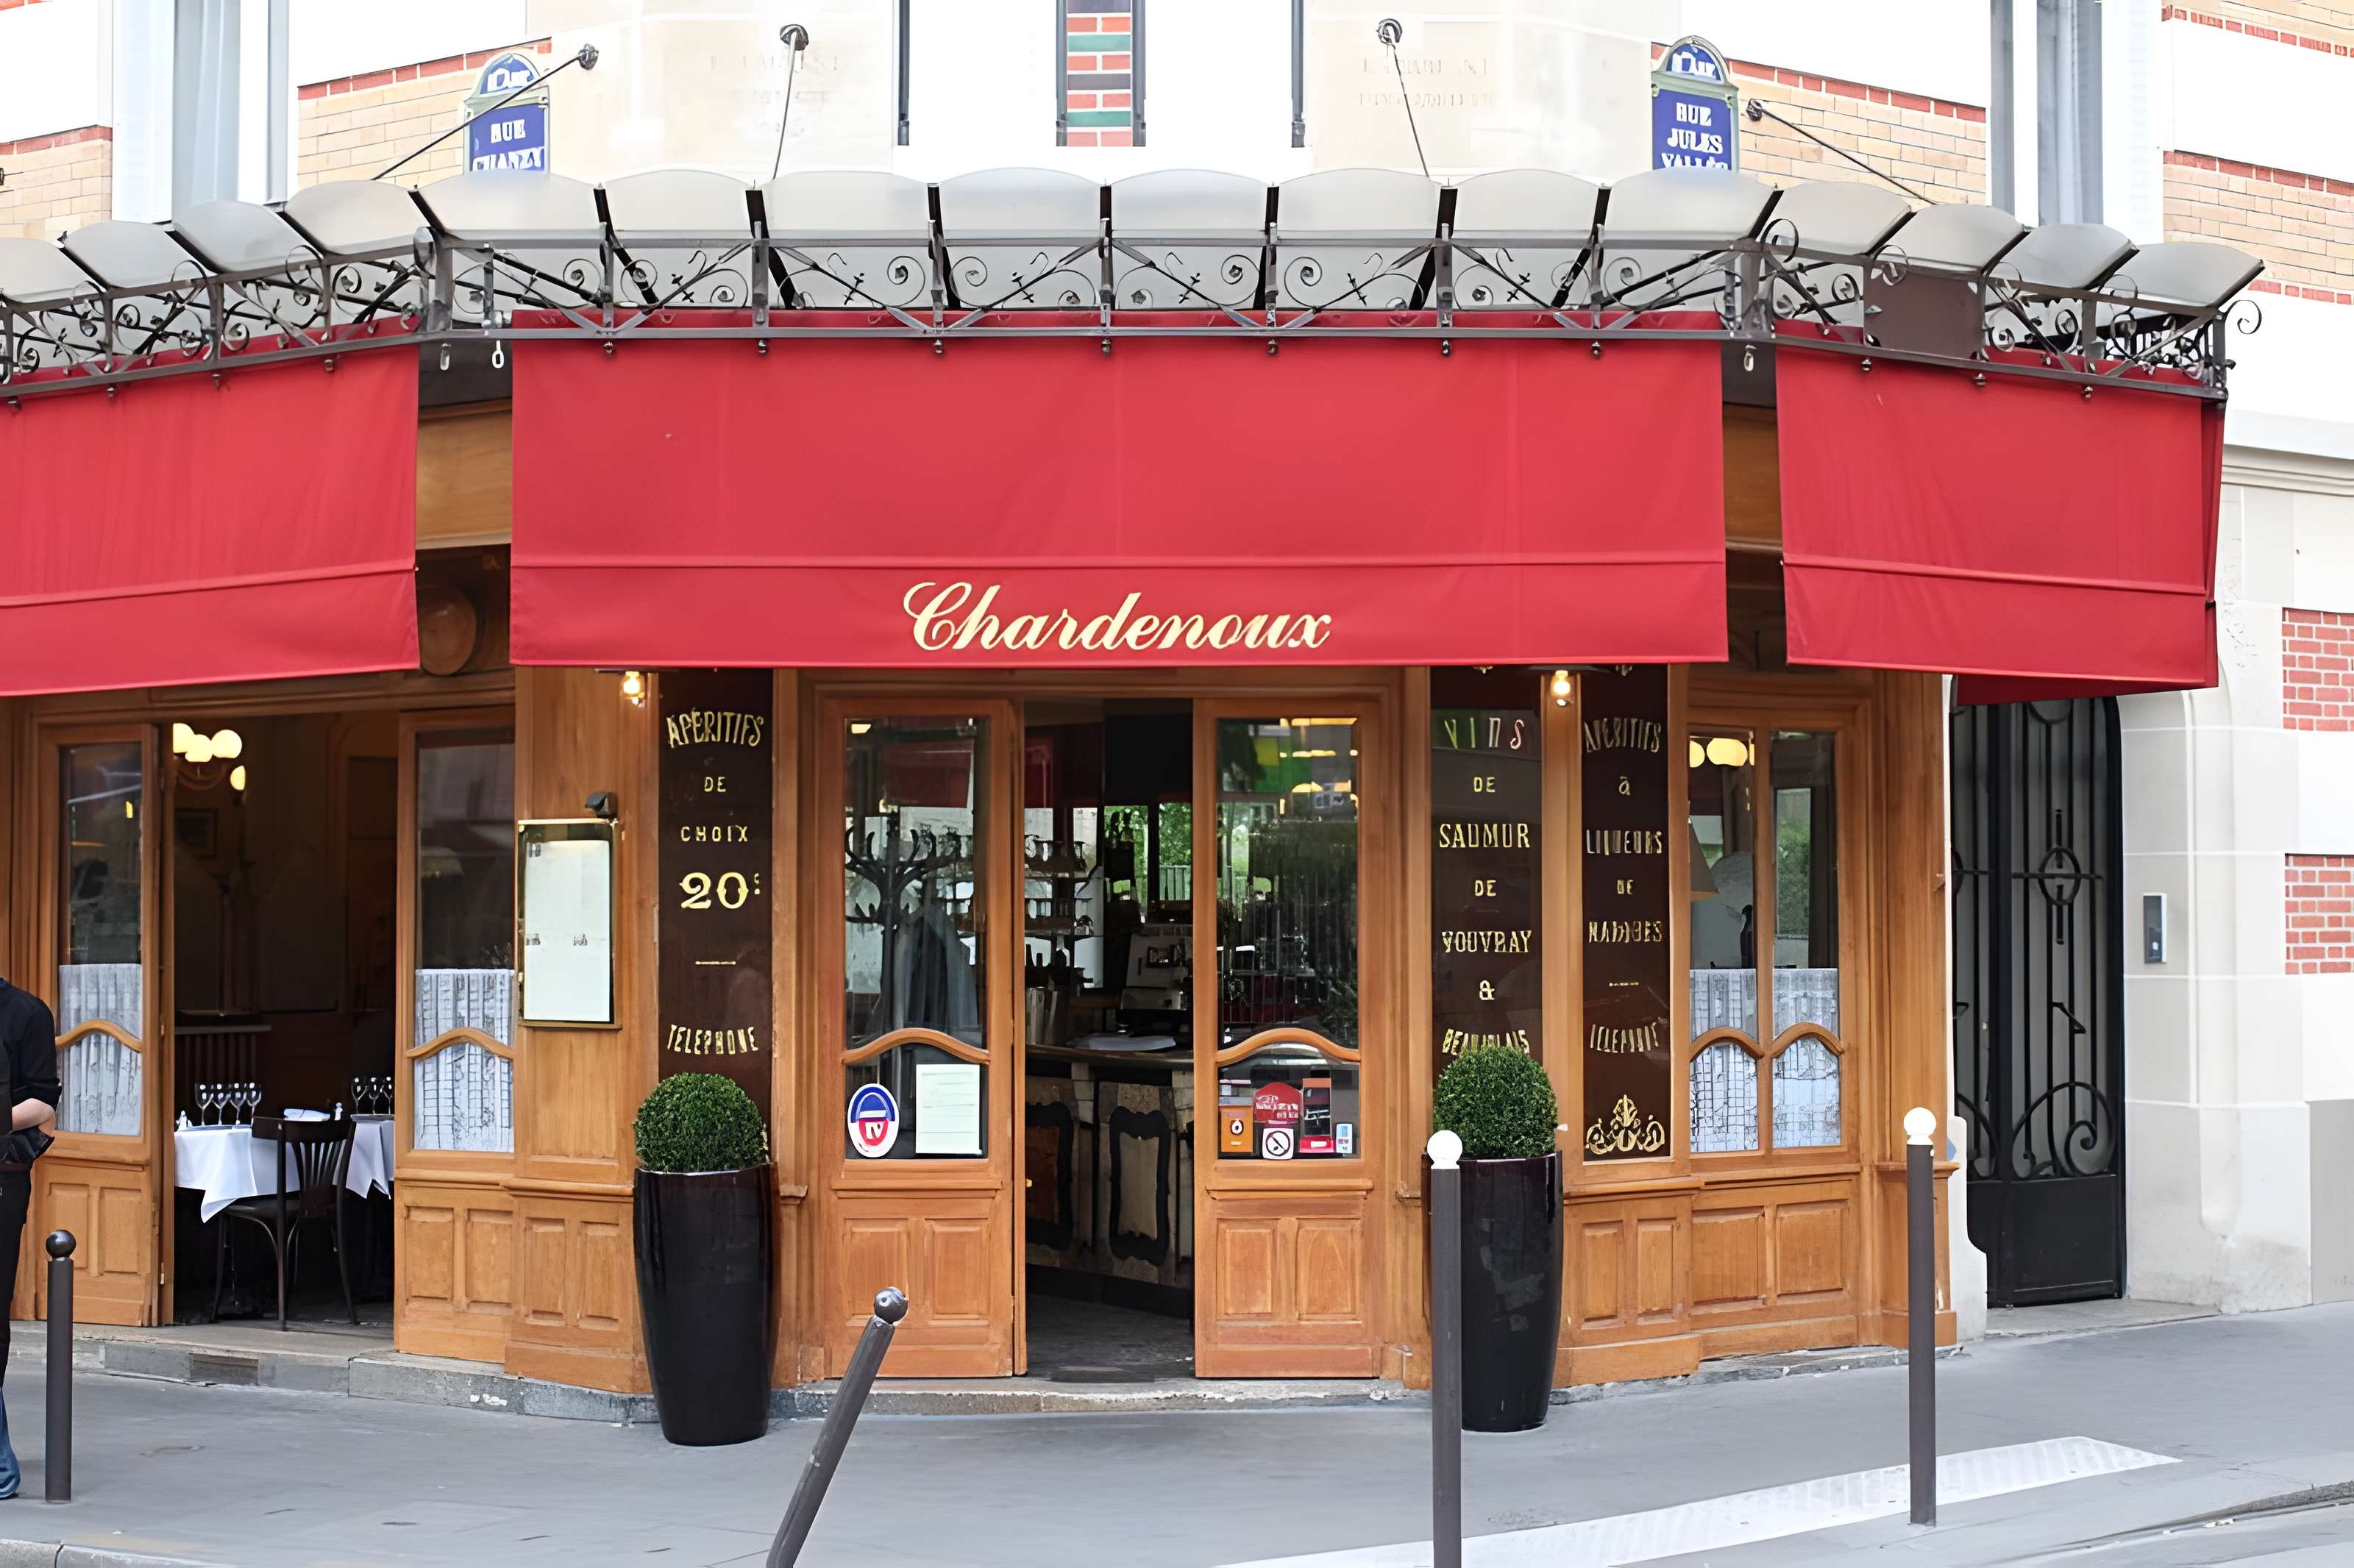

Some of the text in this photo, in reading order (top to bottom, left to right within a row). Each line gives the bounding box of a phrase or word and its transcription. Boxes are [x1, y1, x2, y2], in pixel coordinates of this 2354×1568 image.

[1676, 101, 1712, 126] RUE
[491, 119, 526, 143] RUE
[1667, 128, 1723, 154] JULES
[903, 582, 1332, 651] Chardenoux
[1445, 717, 1525, 749] VINS
[704, 777, 727, 792] DE
[1473, 777, 1496, 793] DE
[680, 824, 748, 842] CHOIX
[1440, 823, 1530, 848] SAUMUR
[1474, 880, 1496, 897] DE
[1479, 980, 1496, 1000] &
